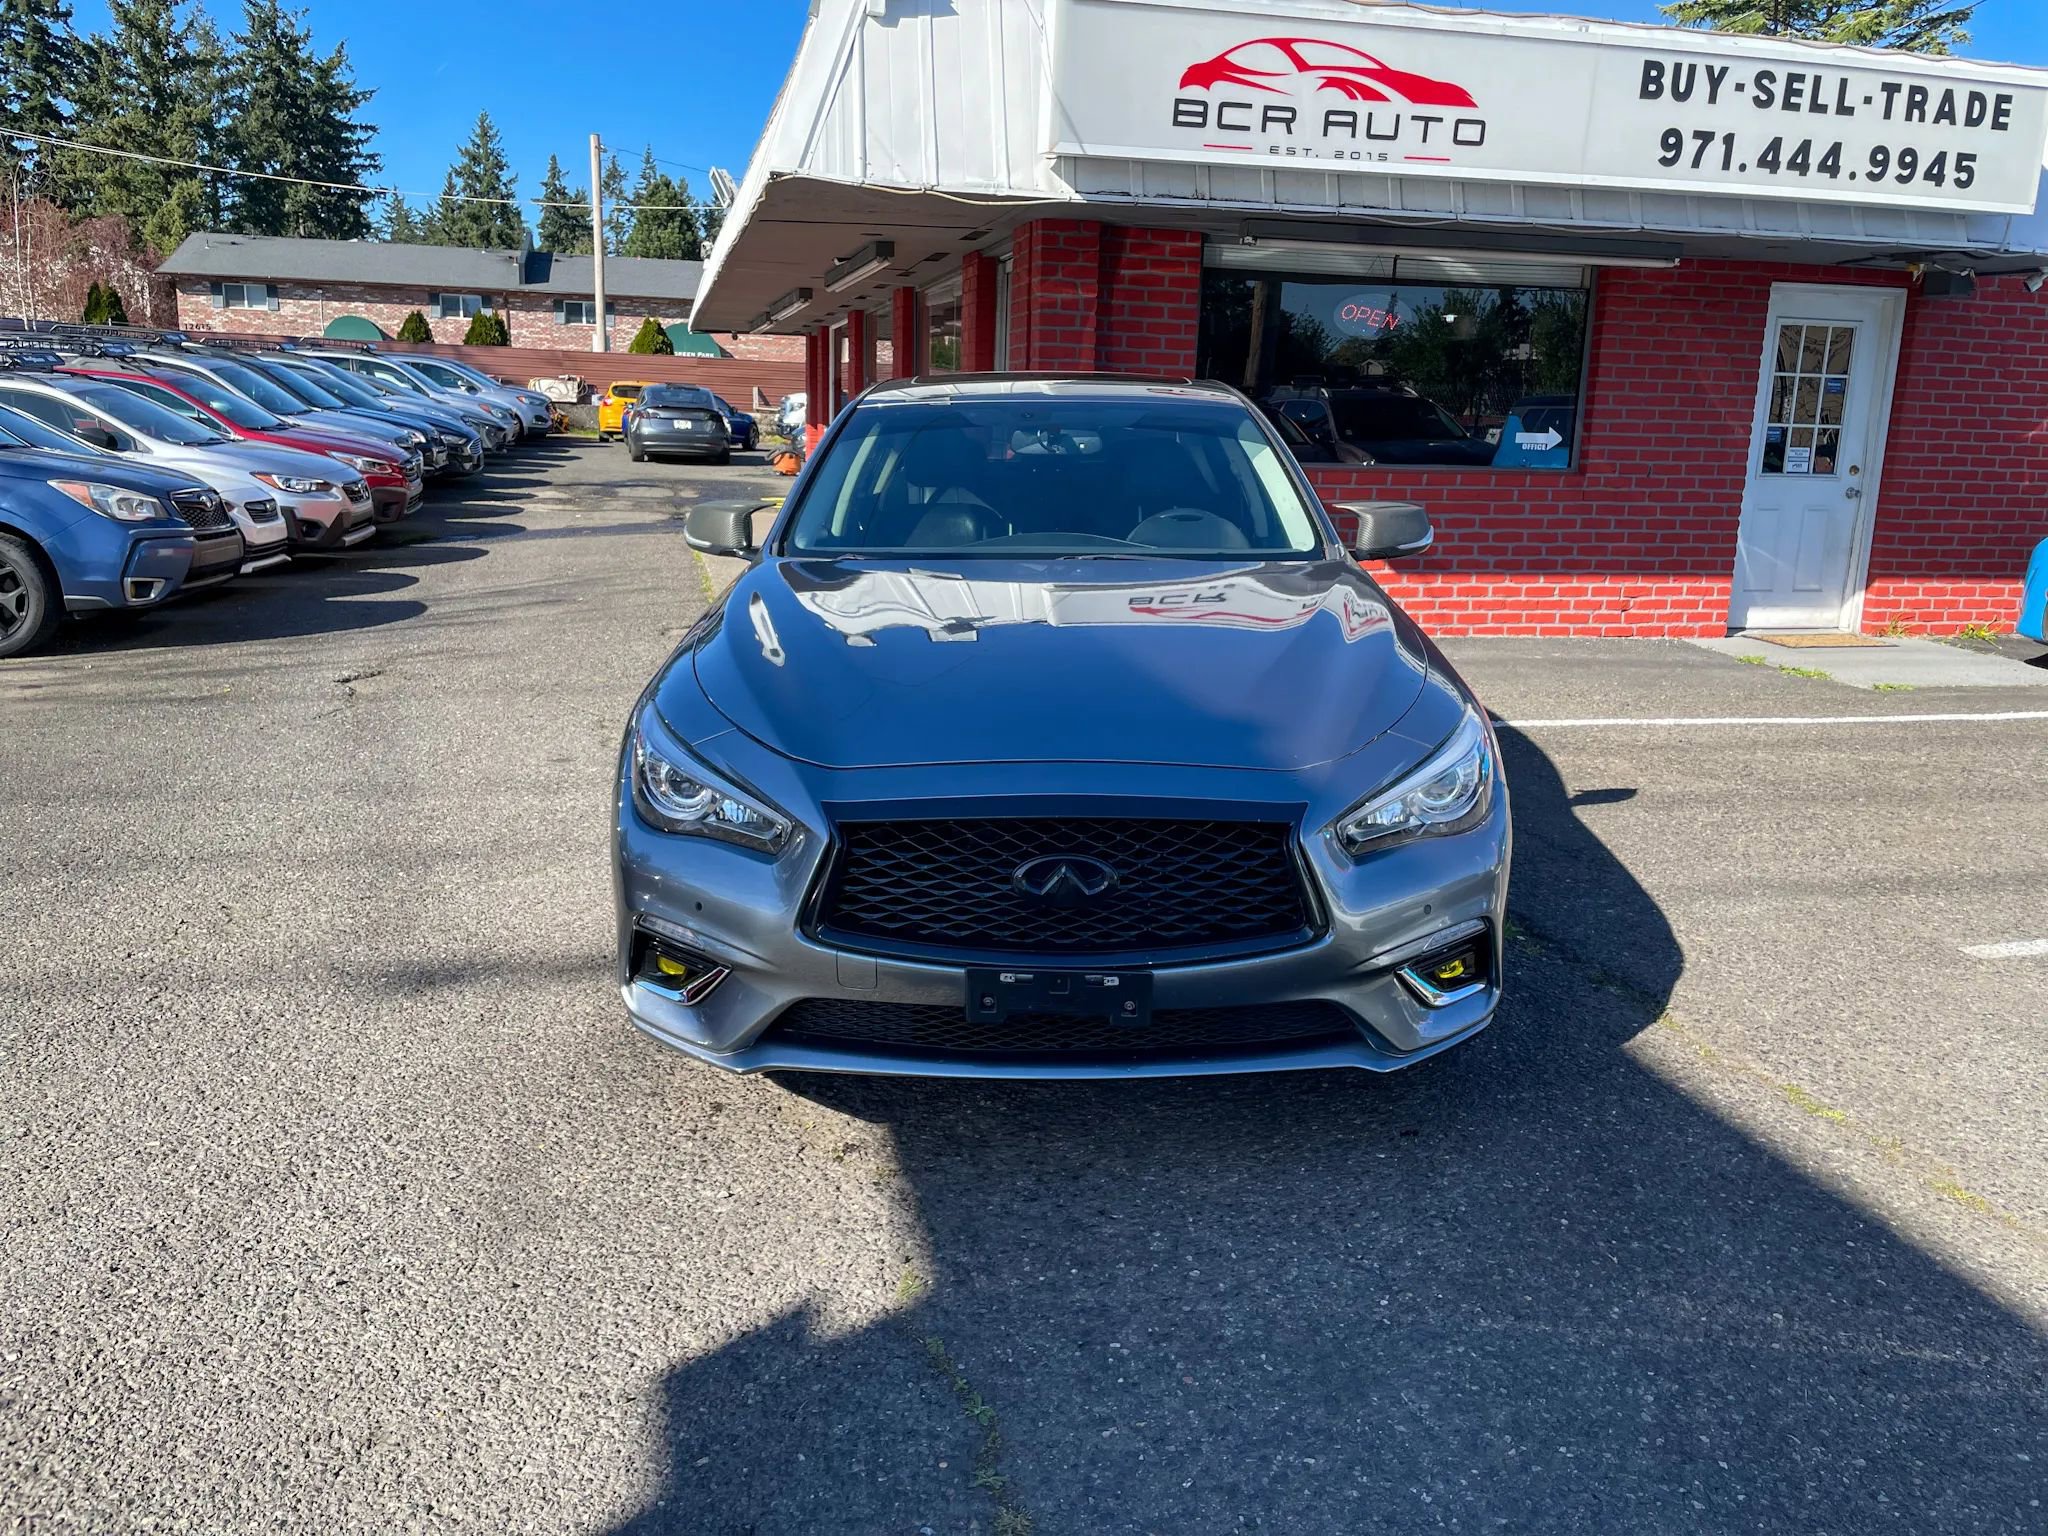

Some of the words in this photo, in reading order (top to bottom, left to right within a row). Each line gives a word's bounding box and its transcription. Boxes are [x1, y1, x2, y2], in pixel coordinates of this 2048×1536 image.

[1638, 59, 2014, 132] BUY-SELL-TRADE
[1172, 97, 1298, 136] BCR
[1322, 109, 1487, 147] AUTO
[1268, 144, 1320, 158] EST.
[1333, 149, 1389, 162] 2015
[1657, 127, 1978, 190] 971.444.9945
[1341, 304, 1401, 330] OPEN
[1521, 443, 1546, 451] OFFICE
